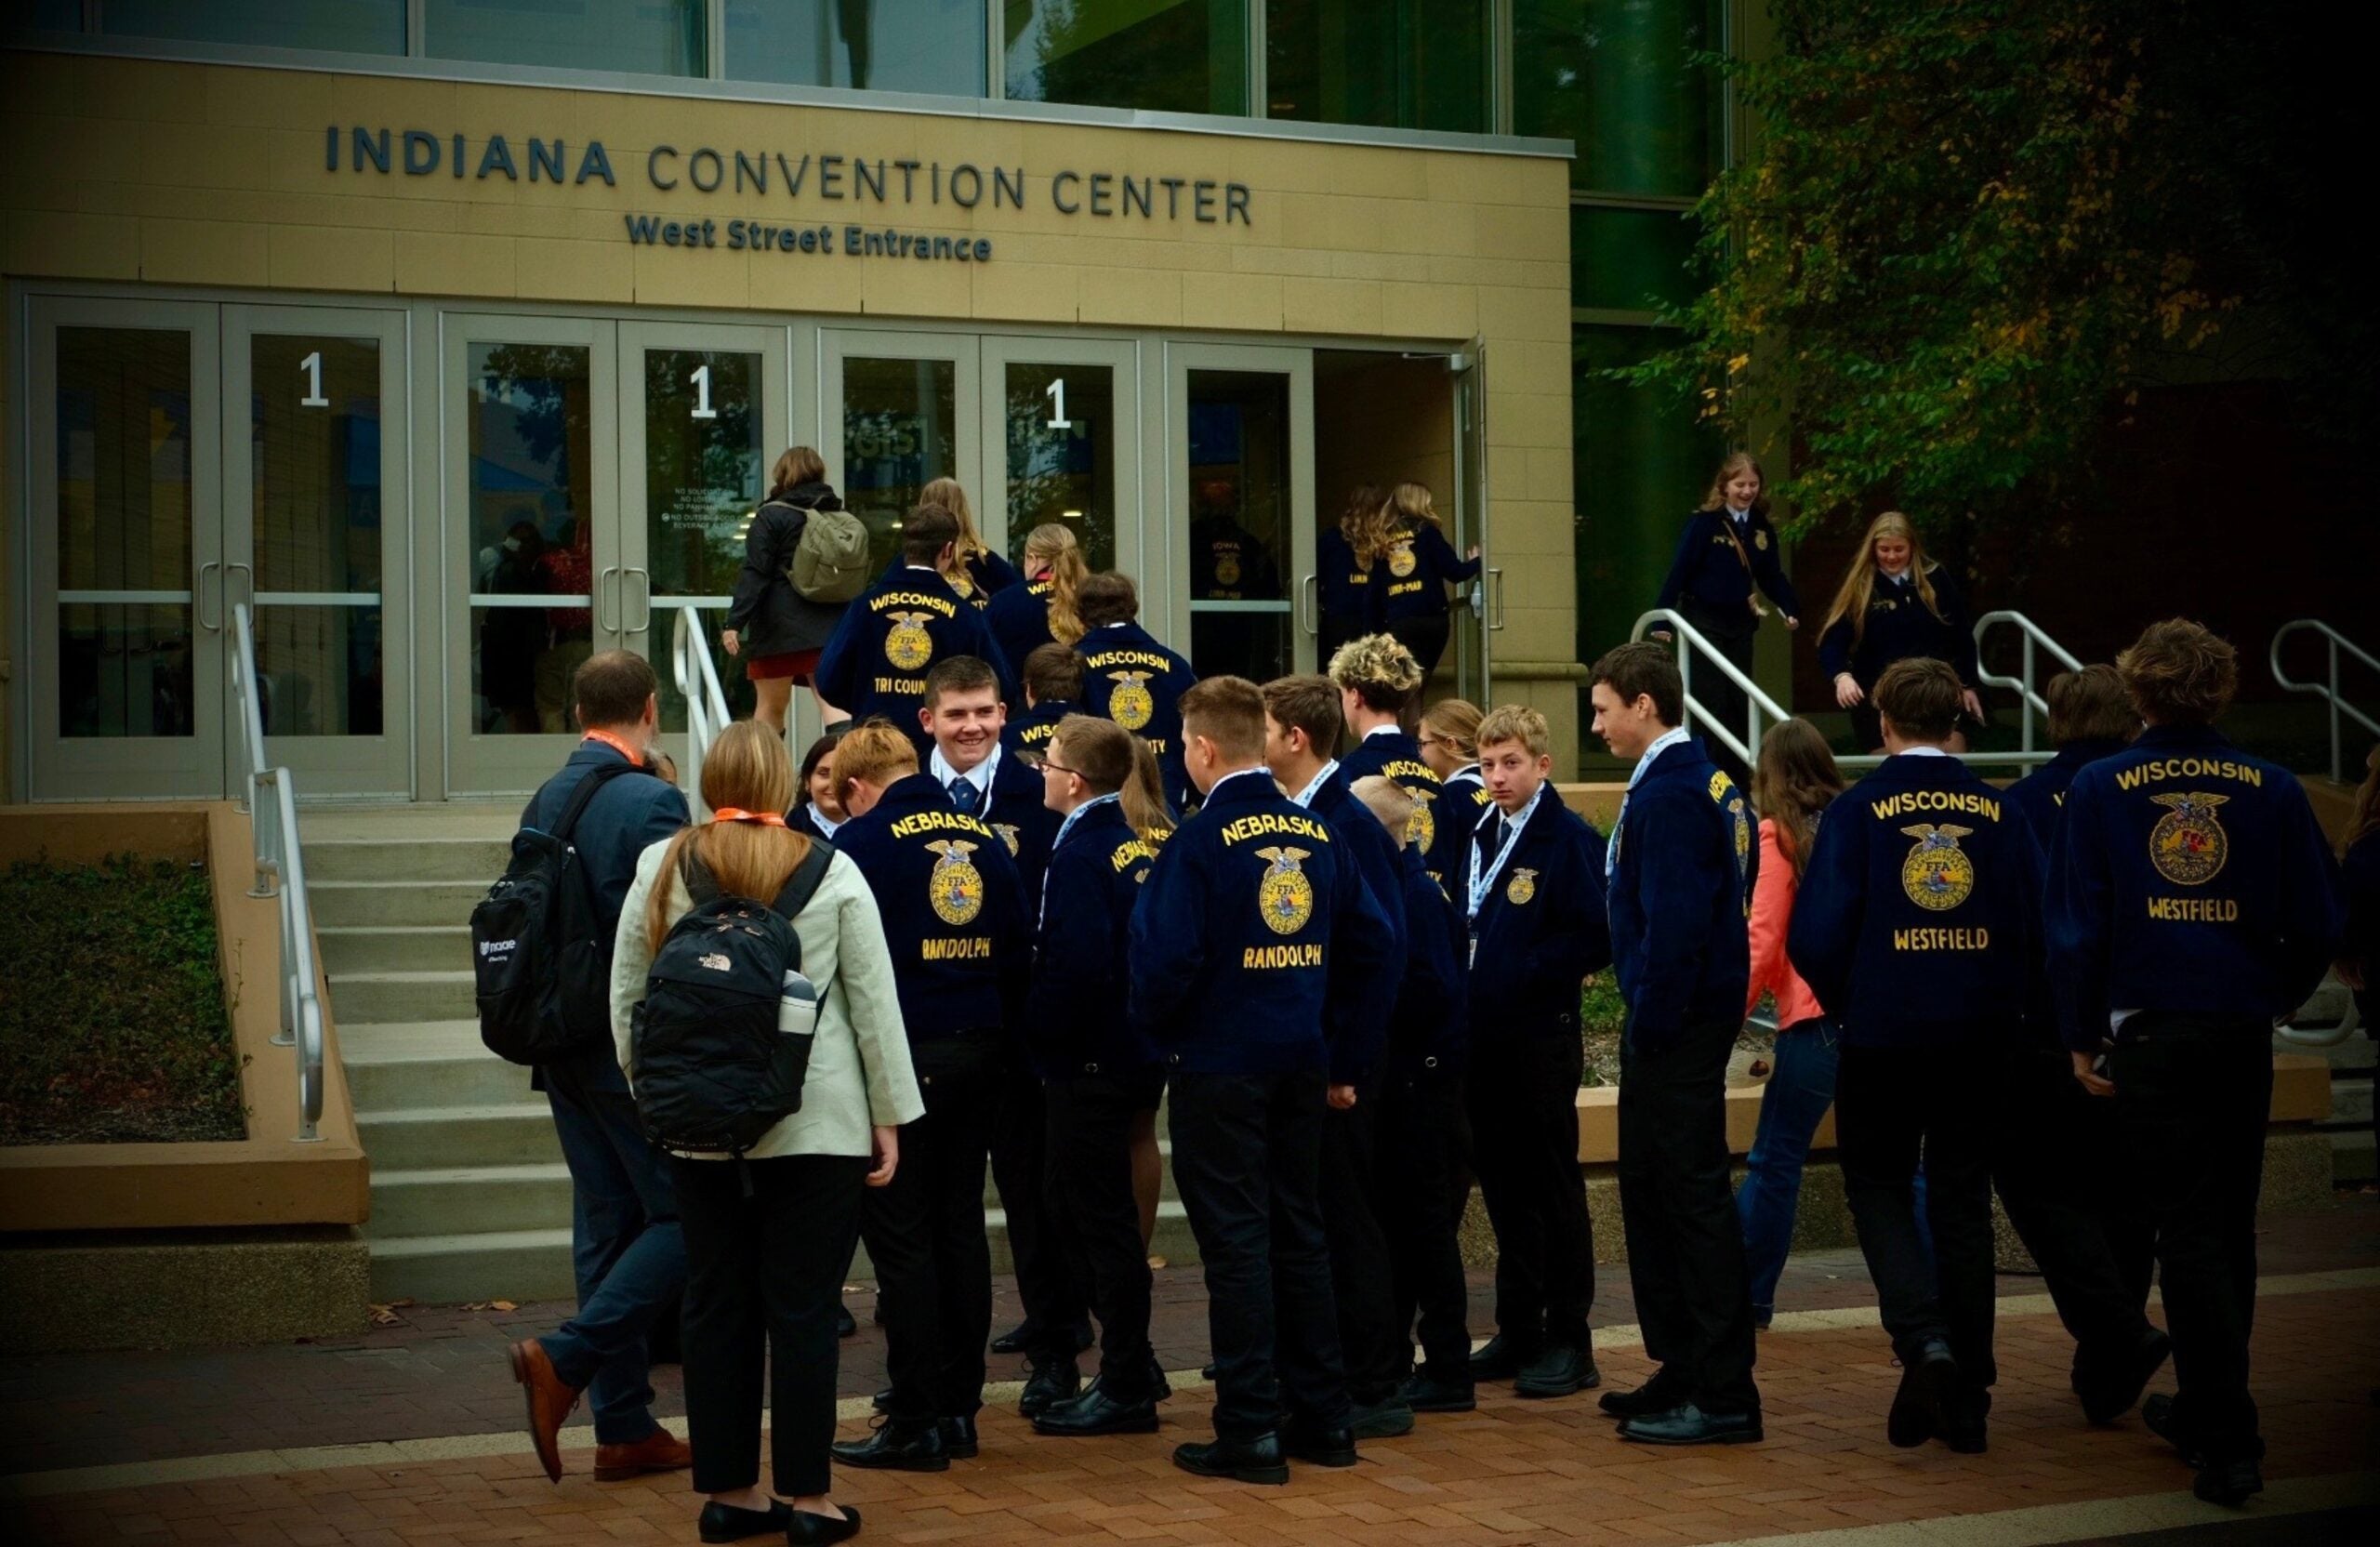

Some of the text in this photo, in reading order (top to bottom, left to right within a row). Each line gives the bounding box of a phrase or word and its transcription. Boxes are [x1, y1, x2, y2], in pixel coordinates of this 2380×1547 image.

[327, 126, 1251, 224] INDIANA CONVENTION CENTER
[626, 215, 991, 261] West Street Entrance
[299, 351, 329, 407] 1
[690, 365, 717, 418] 1
[1046, 378, 1072, 429] 1
[1212, 542, 1240, 551] IOWA
[870, 591, 956, 618] WISCONSIN
[1087, 651, 1170, 673] WISCONSIN
[875, 678, 892, 693] TRI
[2115, 759, 2262, 788] WISCONSIN
[1871, 791, 2001, 823] WISCONSIN
[890, 811, 994, 839] NEBRASKA
[1221, 814, 1329, 847] NEBRASKA
[1925, 862, 1951, 872] FFA
[2148, 895, 2239, 922] WESTFIELD
[921, 937, 991, 960] RANDOLPH
[1894, 928, 1989, 951] WESTFIELD
[1243, 944, 1323, 969] RANDOLPH
